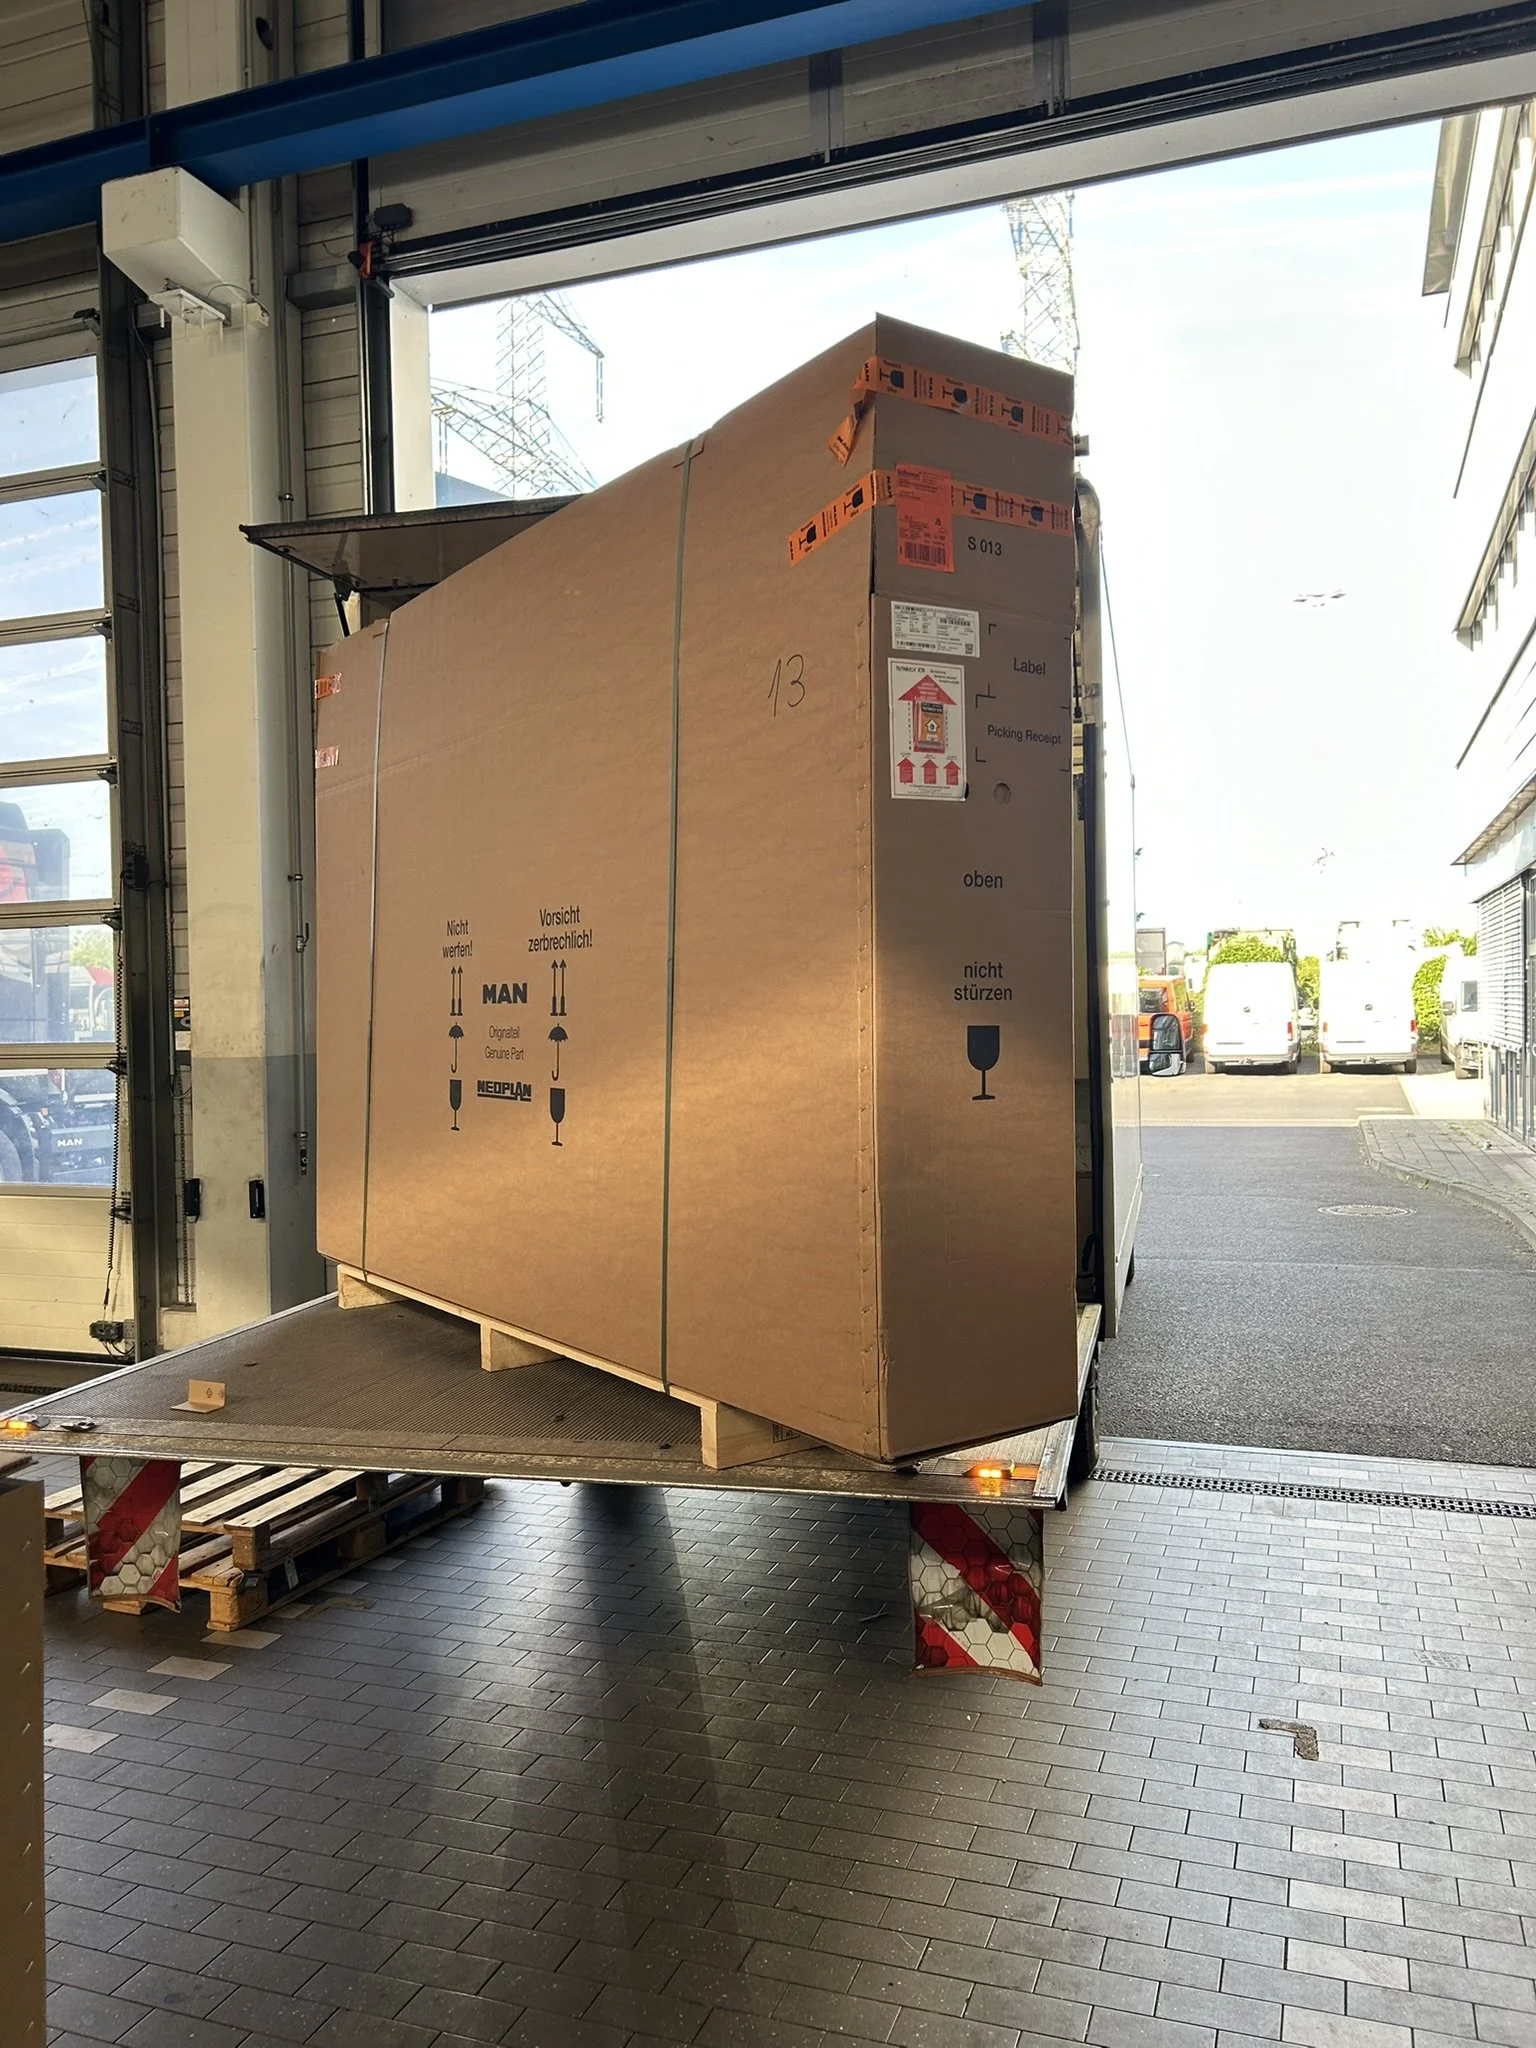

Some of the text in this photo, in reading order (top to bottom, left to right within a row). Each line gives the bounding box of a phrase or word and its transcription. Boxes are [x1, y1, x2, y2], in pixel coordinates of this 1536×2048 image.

[967, 536, 1002, 556] S 013
[1013, 656, 1046, 676] Label
[767, 653, 806, 717] 13
[987, 724, 1062, 747] Picking Receipt
[963, 870, 1003, 889] oben
[539, 905, 581, 927] Vorsicht
[446, 919, 469, 937] Nicht
[442, 941, 473, 959] werfen!
[528, 929, 593, 952] zerbrechlich!
[963, 961, 1004, 979] nicht
[482, 982, 528, 1004] MAN
[953, 984, 1013, 1001] stürzen
[488, 1025, 521, 1042] Originalteil
[484, 1045, 525, 1061] Genuine Part
[477, 1080, 532, 1102] NEOPLAN
[57, 1138, 83, 1147] MAN
